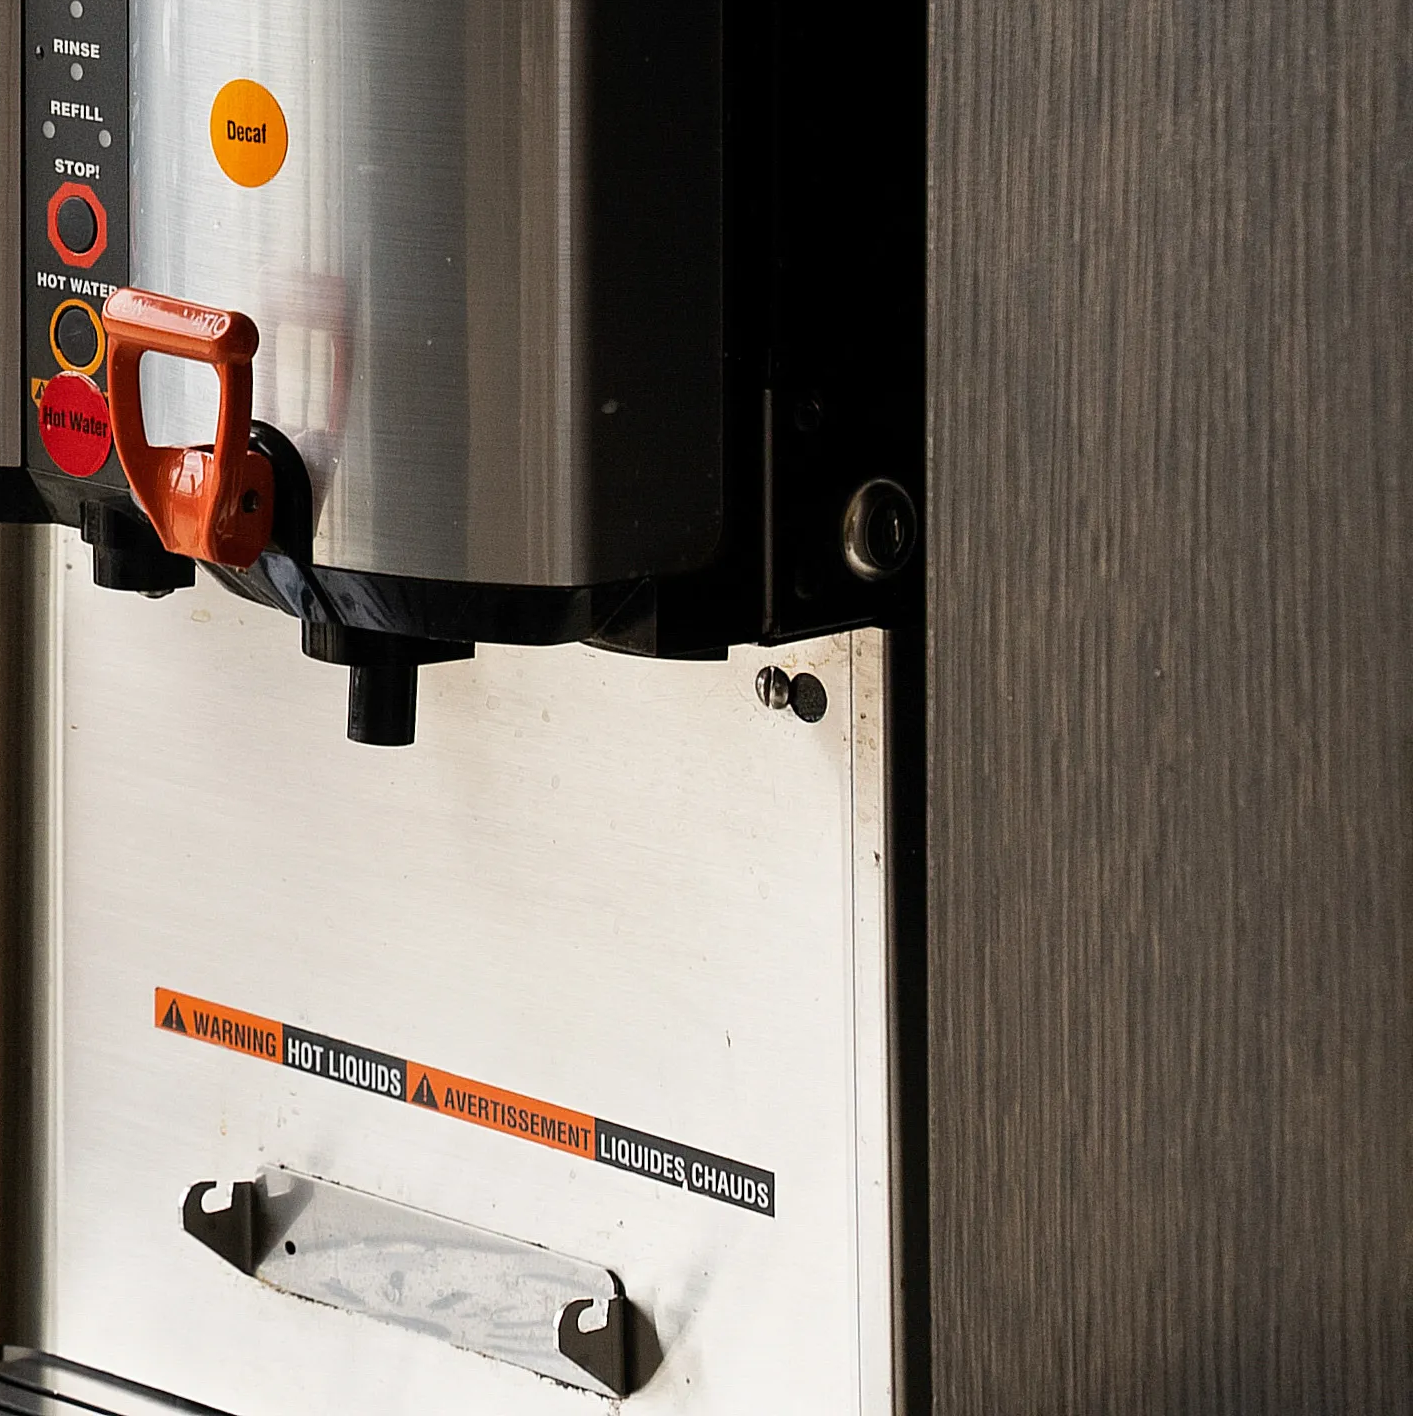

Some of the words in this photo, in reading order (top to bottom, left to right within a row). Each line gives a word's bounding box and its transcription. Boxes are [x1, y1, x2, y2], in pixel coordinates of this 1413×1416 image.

[53, 37, 101, 59] RINSE
[49, 99, 104, 123] REFILL
[226, 119, 267, 144] Decaf
[54, 158, 101, 180] STOP!
[36, 271, 67, 291] HOT
[41, 404, 66, 429] Hot
[71, 410, 109, 438] Water
[193, 1009, 277, 1058] WARNING
[287, 1037, 324, 1073] HOT
[328, 1049, 402, 1097] LIQUIDS
[444, 1086, 592, 1152] AVERTISSEMENT
[599, 1133, 687, 1182] LIQUIDES
[690, 1161, 770, 1209] CHAUDS
